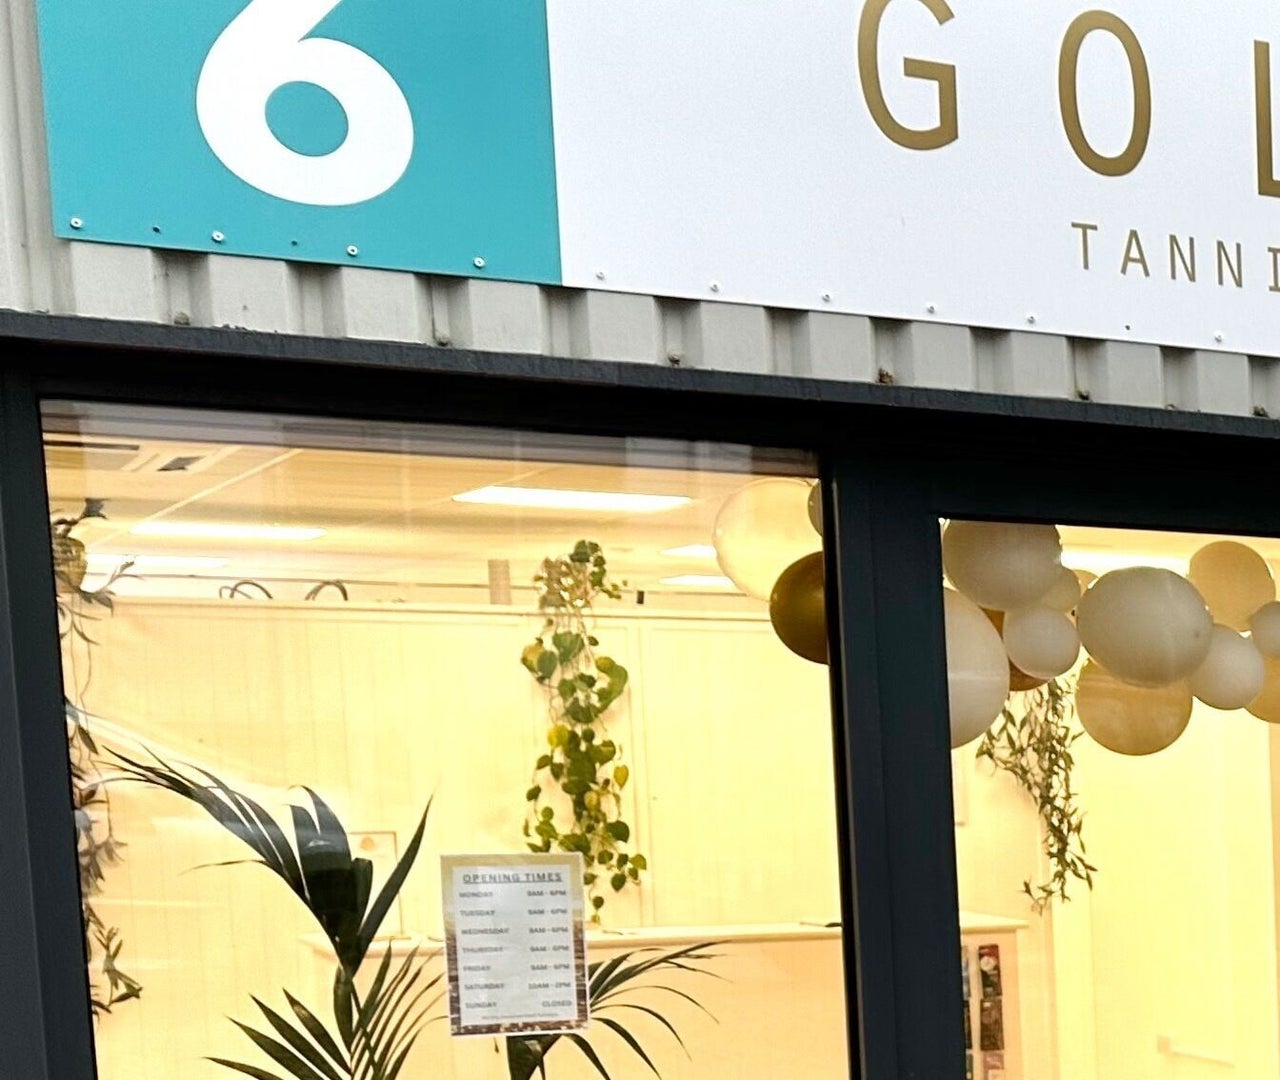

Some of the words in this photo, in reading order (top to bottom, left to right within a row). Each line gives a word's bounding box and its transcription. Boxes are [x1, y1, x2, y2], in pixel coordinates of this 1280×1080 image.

[195, 0, 414, 206] 6
[463, 873, 521, 884] OPENING
[525, 872, 562, 882] TIMES
